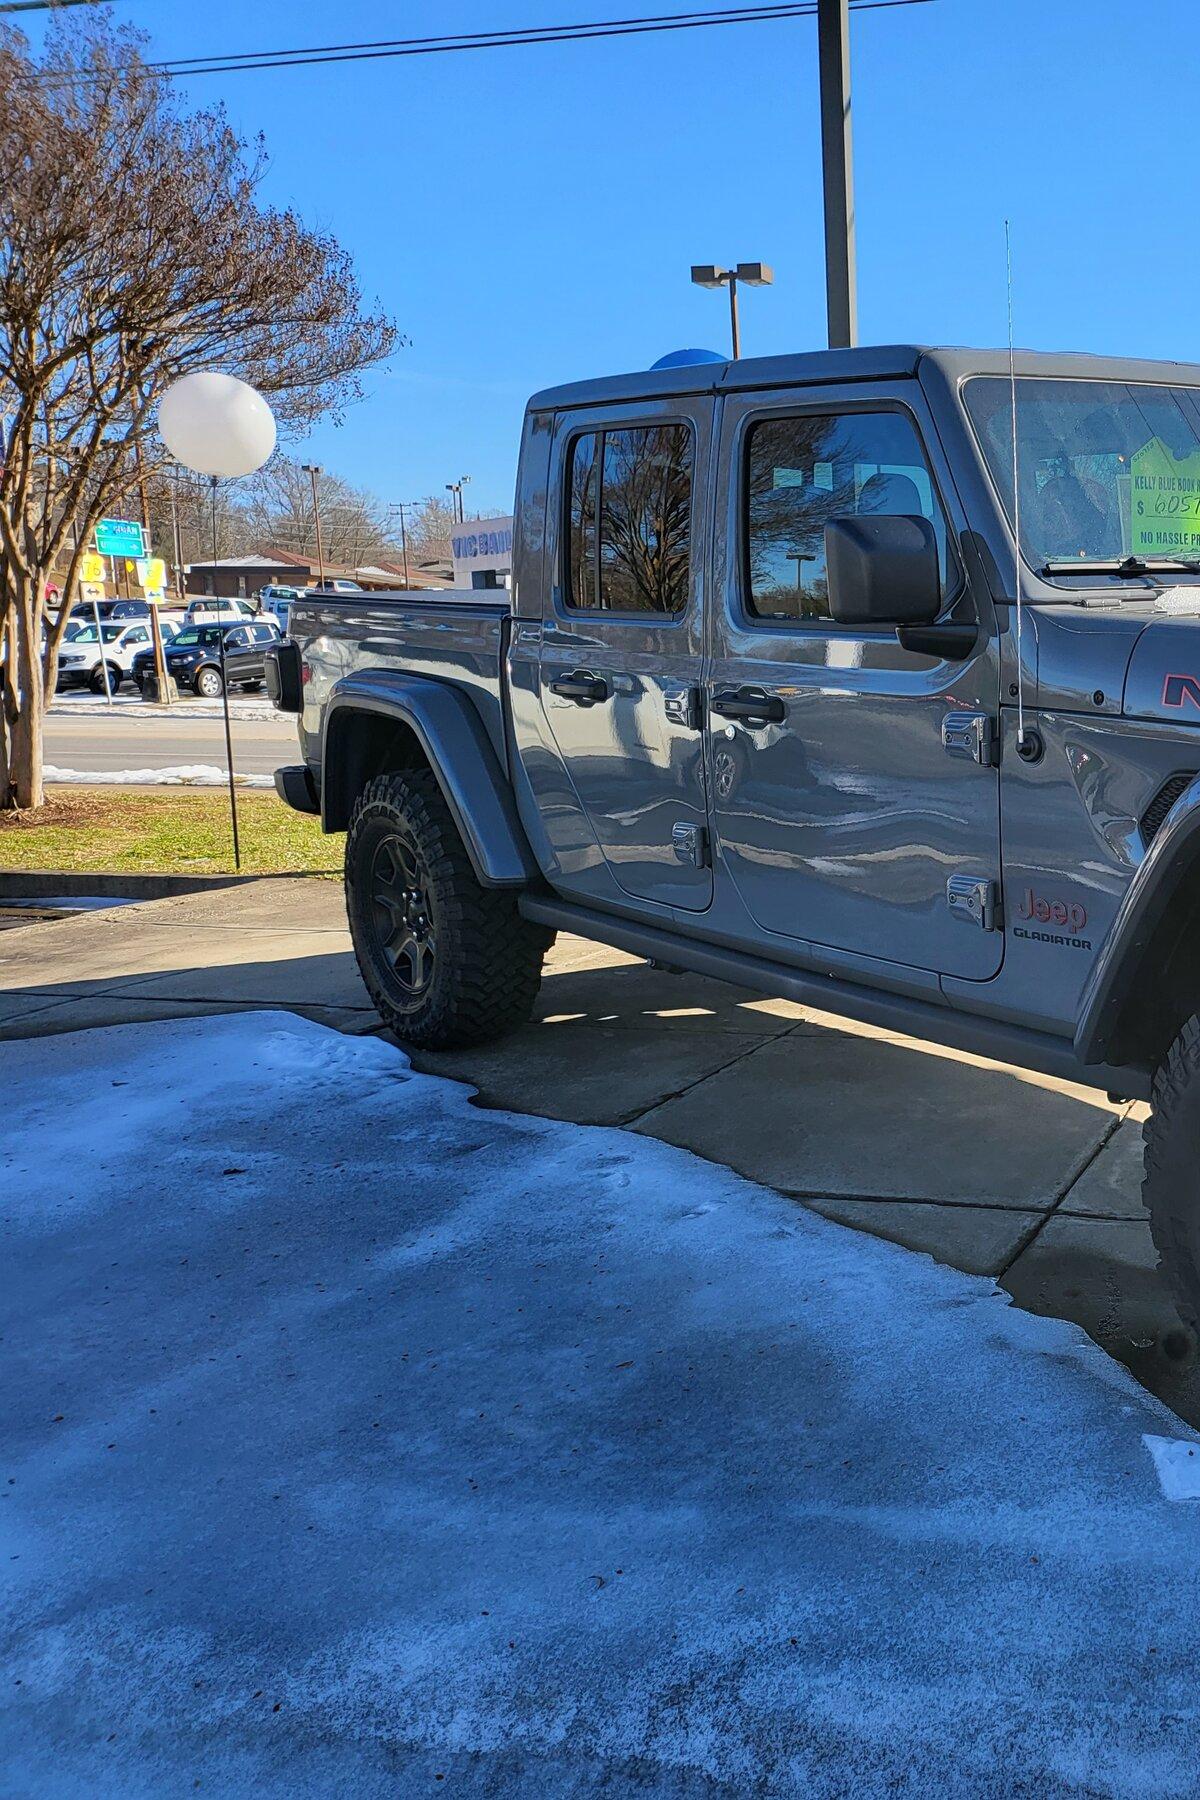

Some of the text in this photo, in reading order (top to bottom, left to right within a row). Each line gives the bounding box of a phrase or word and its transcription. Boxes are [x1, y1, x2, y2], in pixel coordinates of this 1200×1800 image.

[1135, 475, 1156, 490] KELLY
[1159, 475, 1176, 491] BLUE
[1178, 477, 1195, 492] BOOK
[1137, 500, 1144, 516] $
[452, 535, 477, 559] VIC
[1141, 531, 1153, 543] NO
[1156, 532, 1189, 545] HASSLE
[1017, 888, 1087, 934] Jeep
[1013, 927, 1092, 951] GLADIATOR
